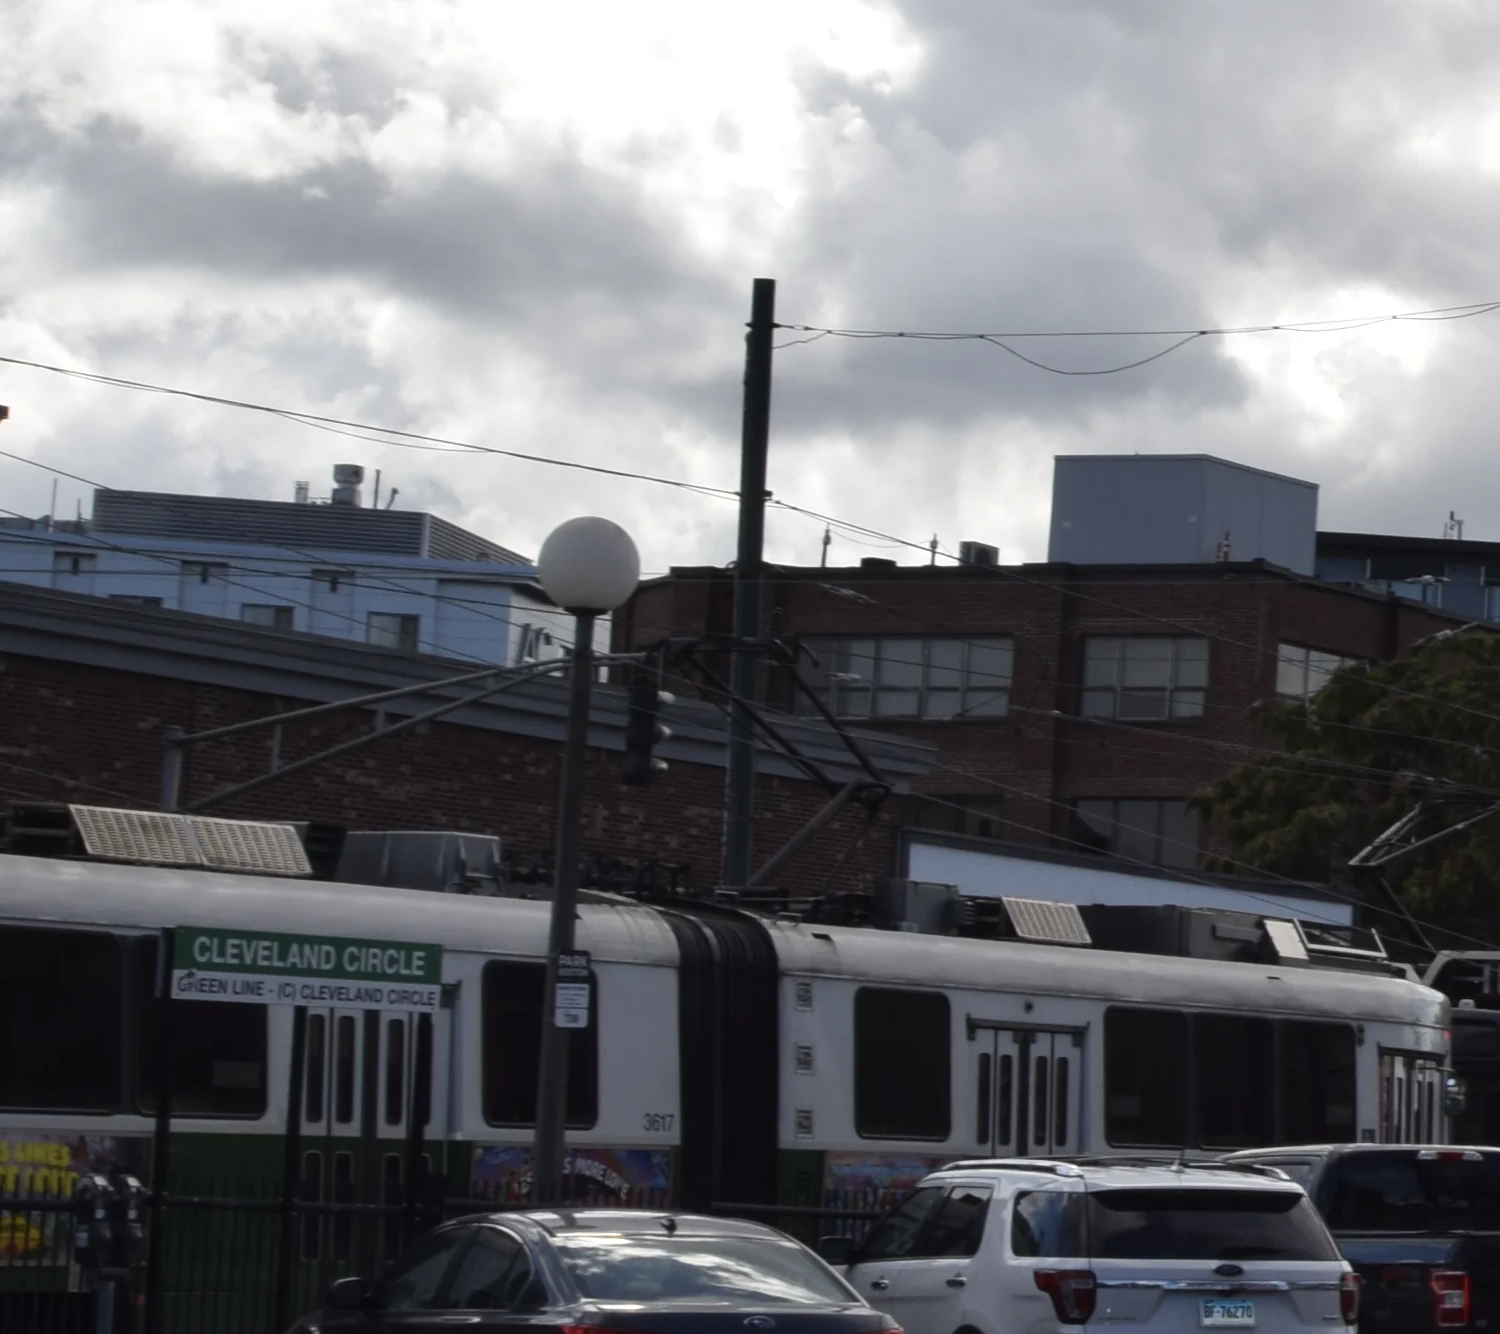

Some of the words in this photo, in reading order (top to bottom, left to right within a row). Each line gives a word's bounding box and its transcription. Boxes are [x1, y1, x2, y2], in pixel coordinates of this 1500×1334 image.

[192, 935, 337, 971] CLEVELAND
[341, 945, 427, 976] CIRCLE
[177, 974, 229, 995] GREEN
[232, 978, 266, 997] LINE
[277, 981, 297, 1002] (C)
[300, 984, 384, 1005] CLEVELAND
[386, 988, 437, 1008] CIRCLE
[643, 1113, 676, 1132] 3617
